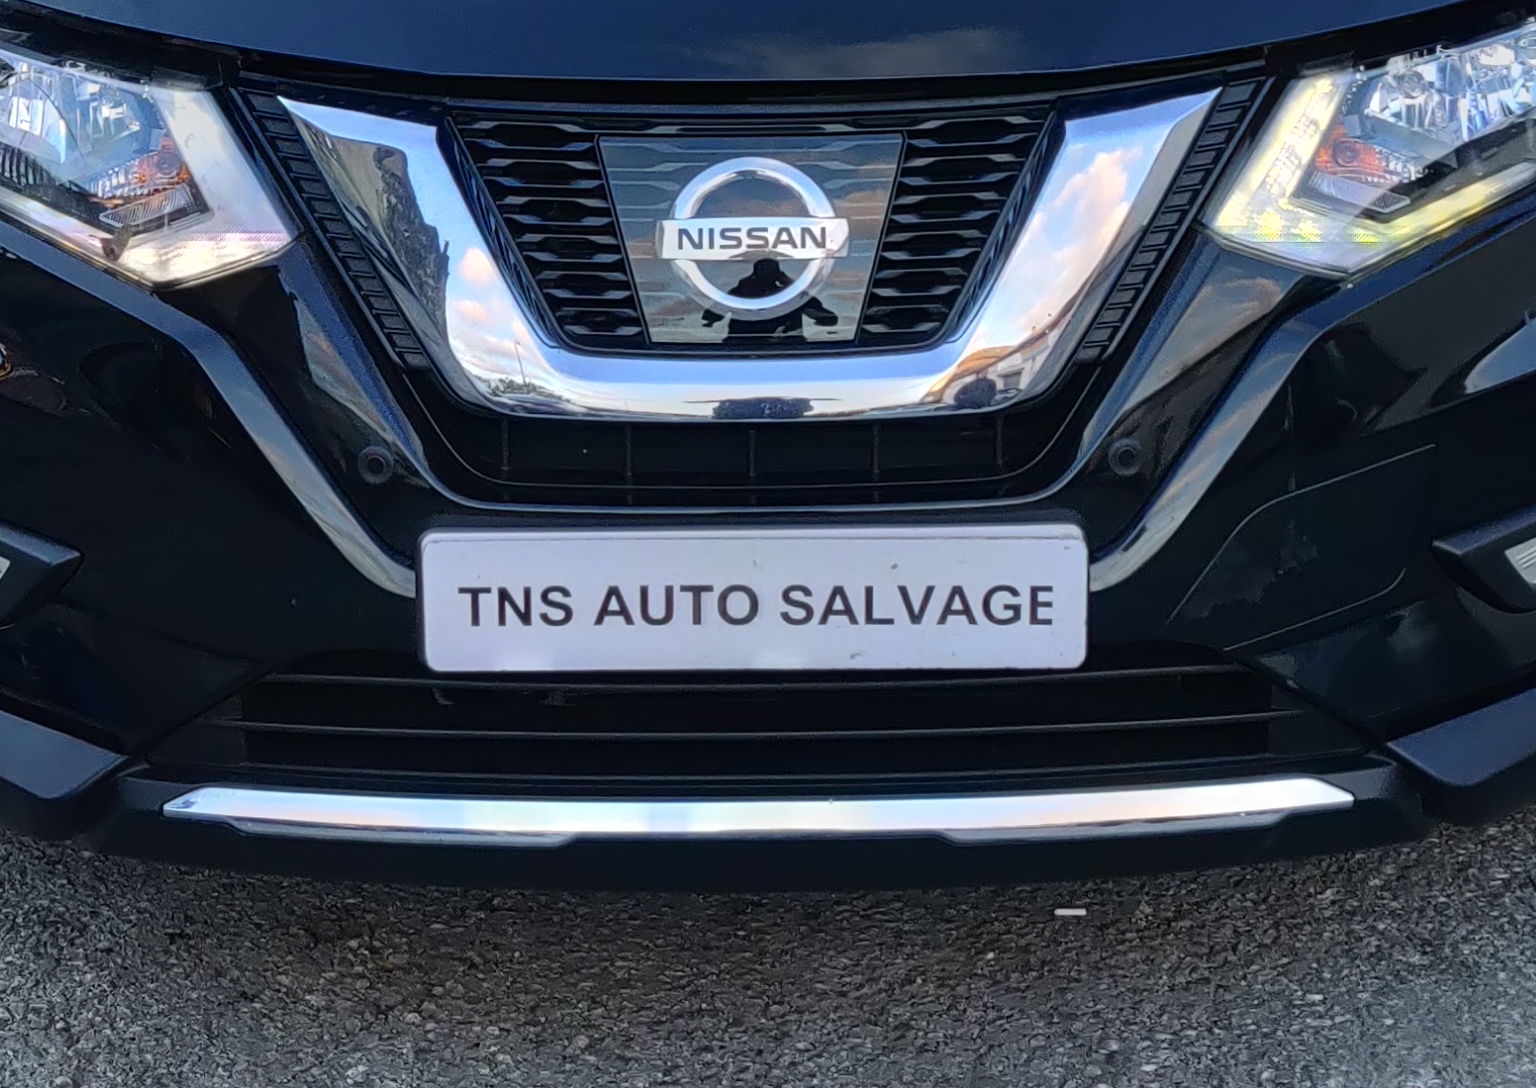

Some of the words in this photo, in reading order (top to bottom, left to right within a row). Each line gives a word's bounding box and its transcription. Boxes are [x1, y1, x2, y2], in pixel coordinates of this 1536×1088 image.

[677, 227, 826, 250] NISSAN
[458, 586, 573, 627] TNS
[594, 585, 760, 627] AUTO
[779, 584, 1054, 626] SALVAGE
